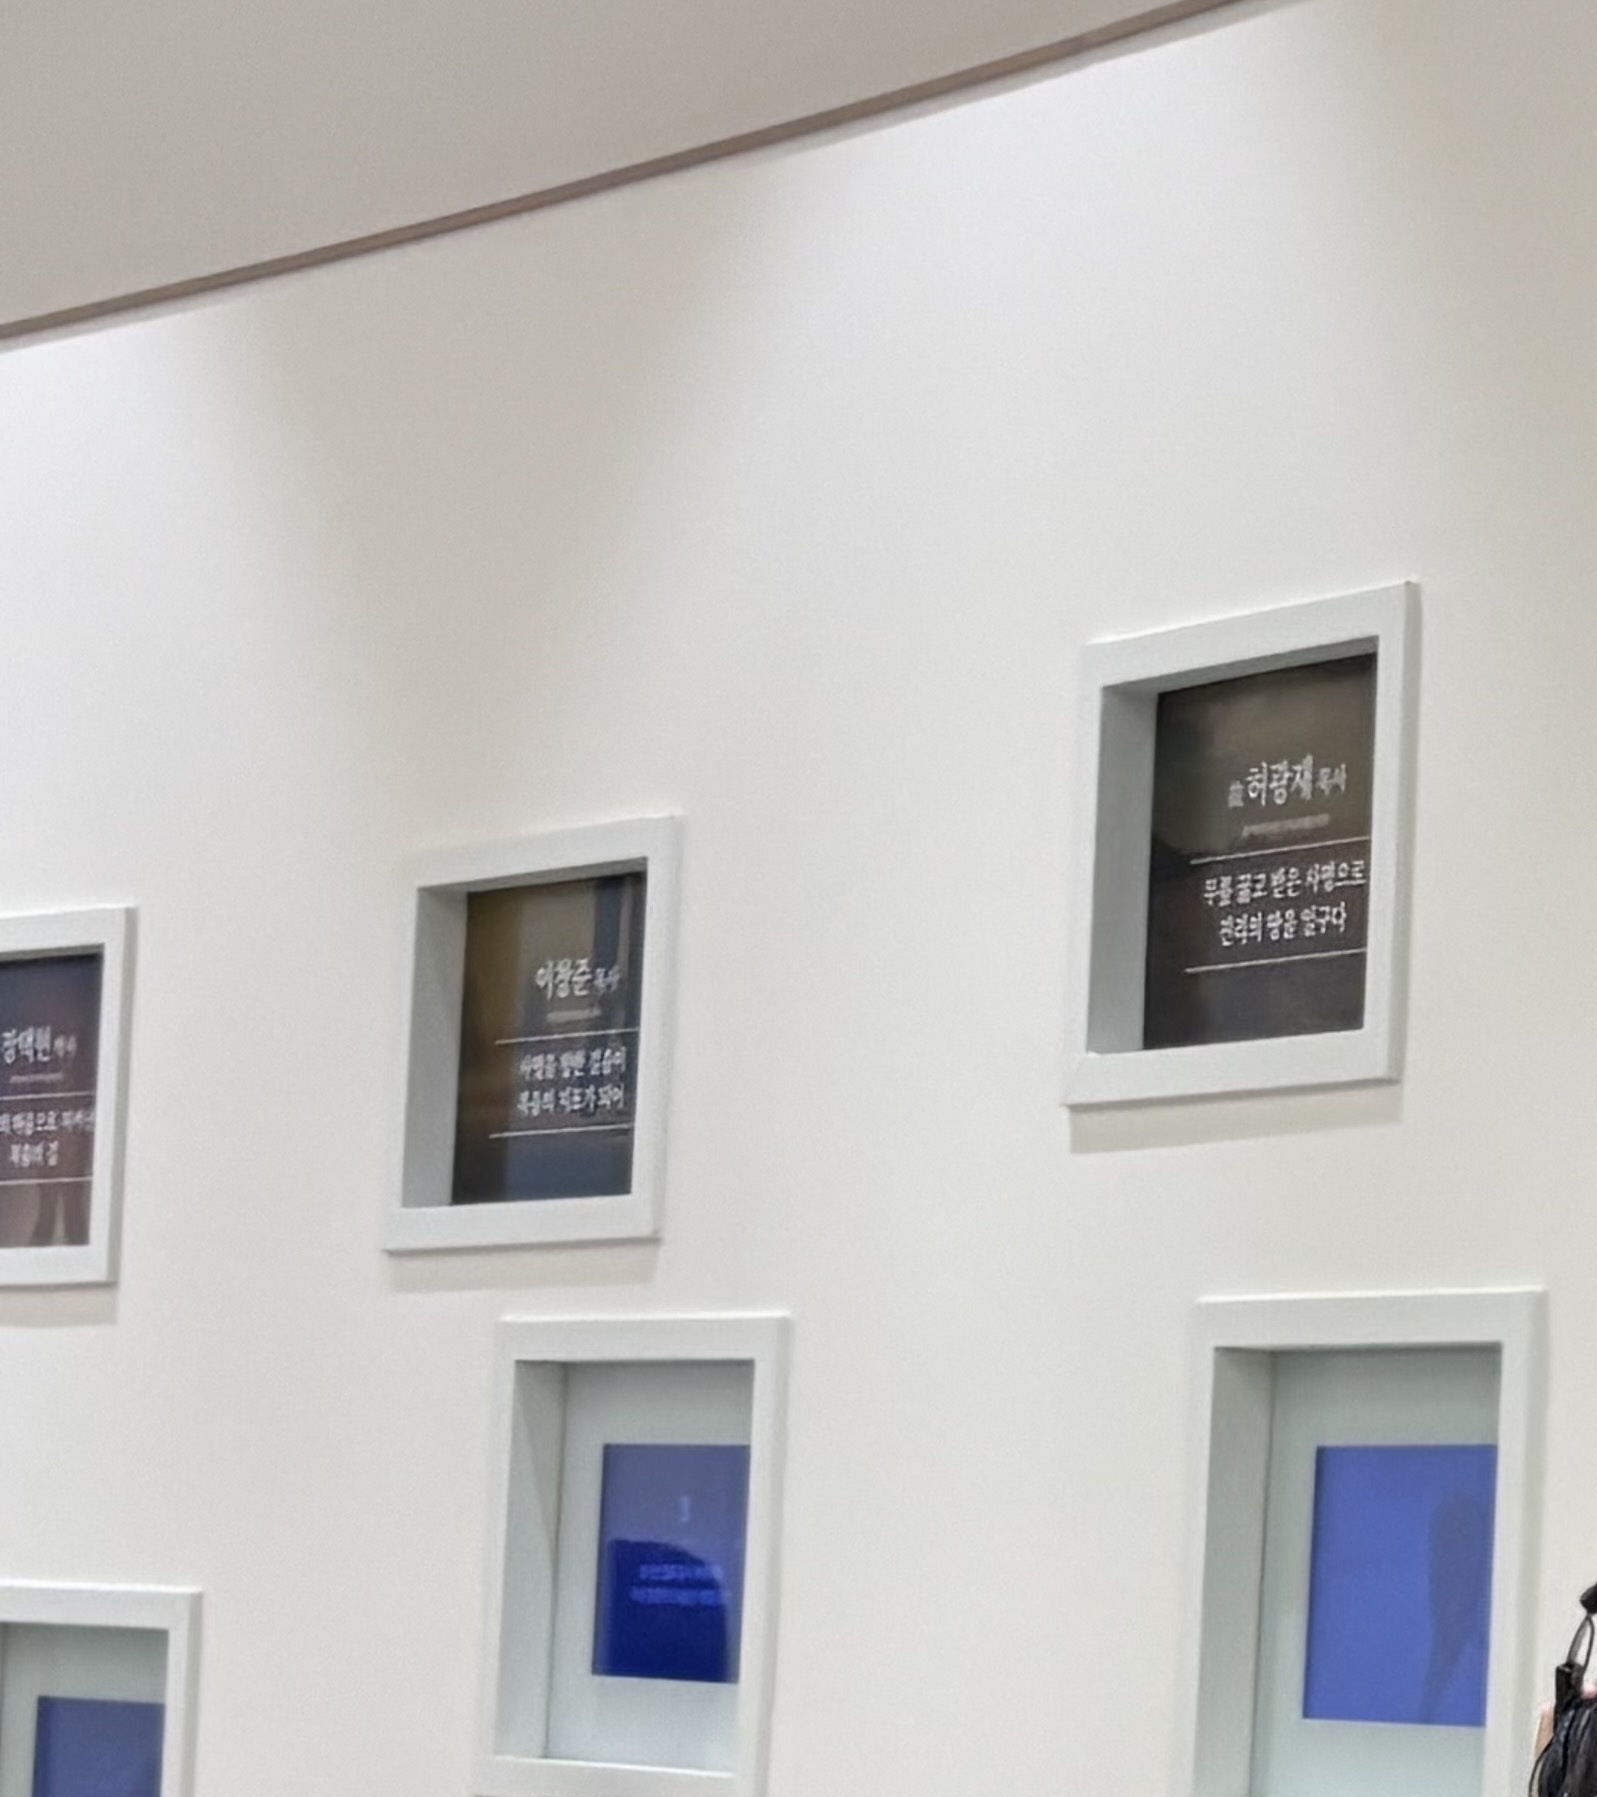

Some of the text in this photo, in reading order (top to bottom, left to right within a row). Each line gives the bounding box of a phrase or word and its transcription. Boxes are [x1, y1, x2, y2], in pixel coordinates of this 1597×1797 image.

[1246, 754, 1313, 806] 허광재
[1315, 763, 1346, 795] 목사
[1305, 860, 1367, 893] 사명으로
[1300, 901, 1347, 937] 일구다
